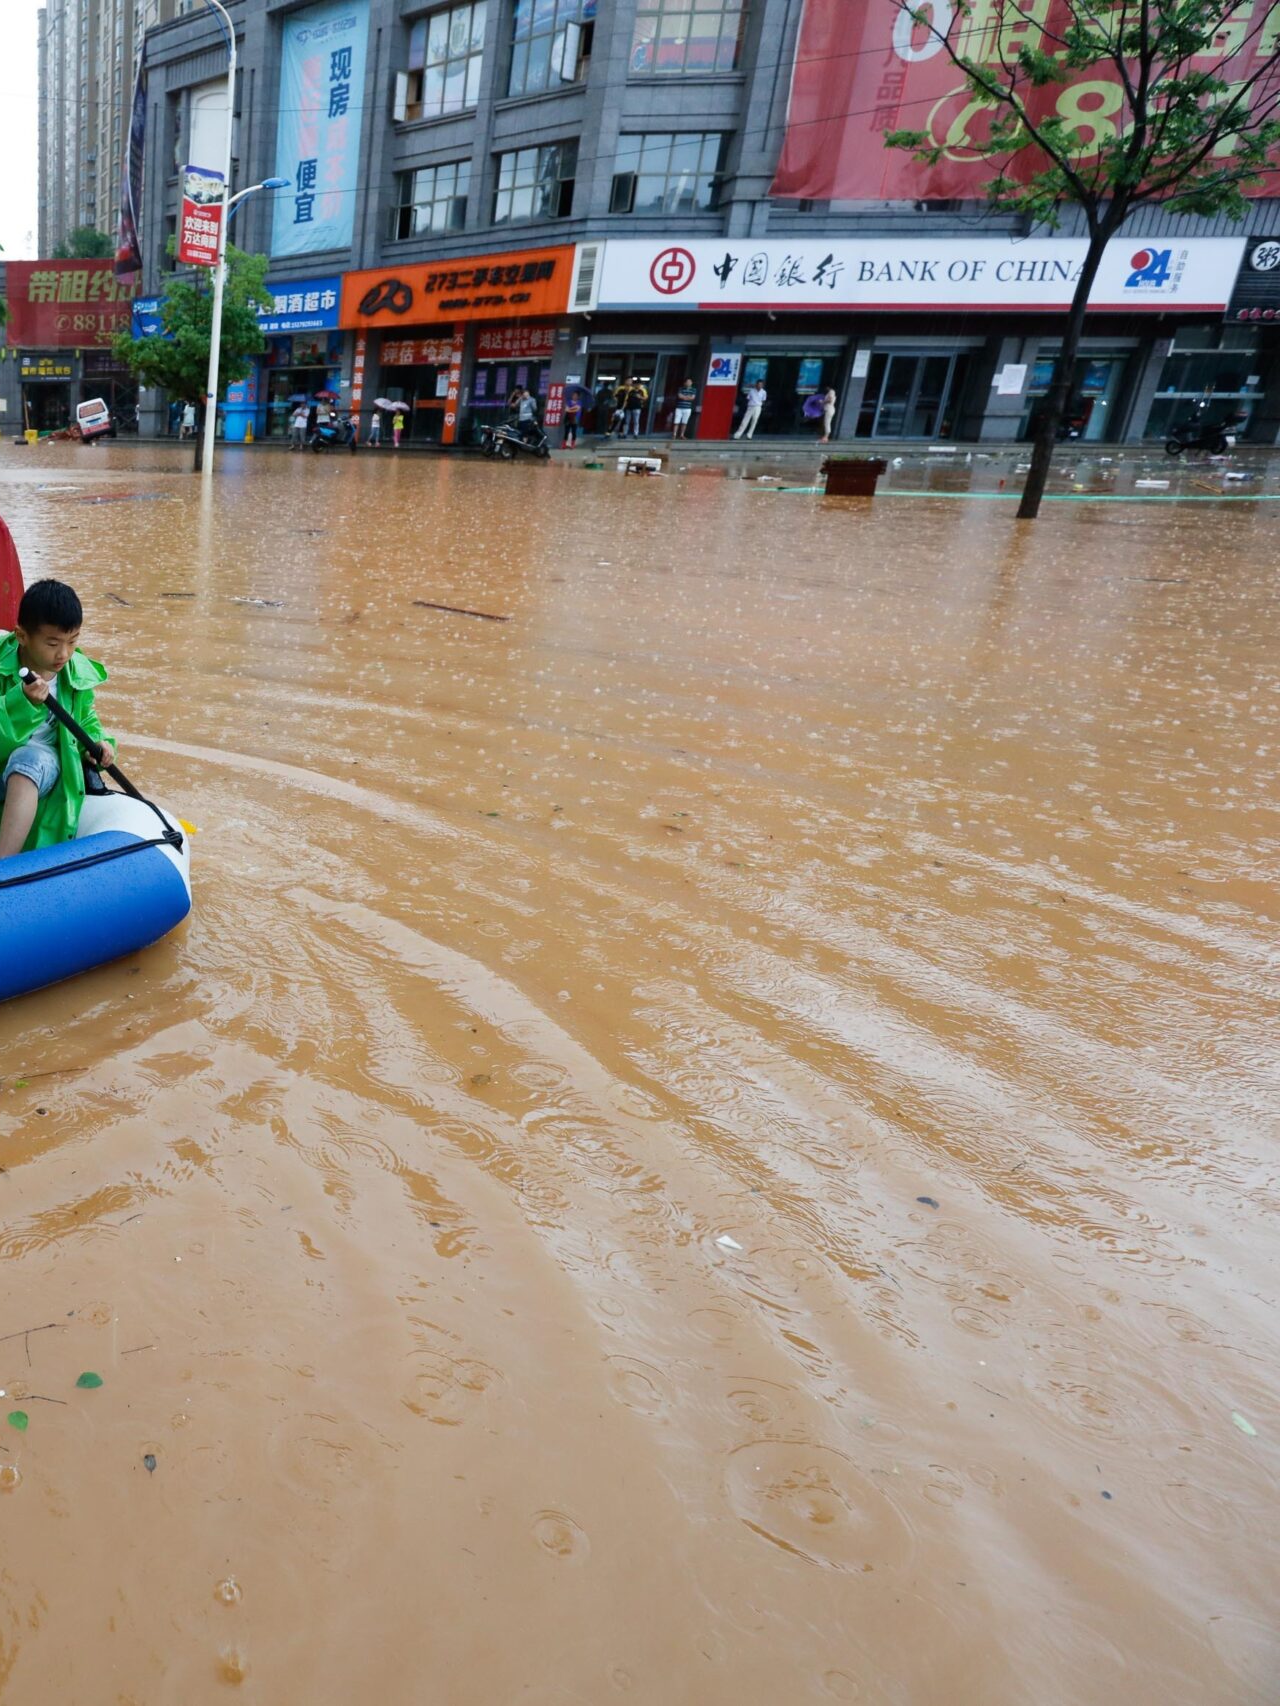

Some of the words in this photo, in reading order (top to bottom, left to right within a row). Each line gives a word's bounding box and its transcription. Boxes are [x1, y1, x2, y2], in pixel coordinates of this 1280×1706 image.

[857, 260, 940, 282] BANK
[947, 260, 986, 282] OF
[995, 260, 1086, 282] CHINA
[1124, 248, 1172, 287] 24
